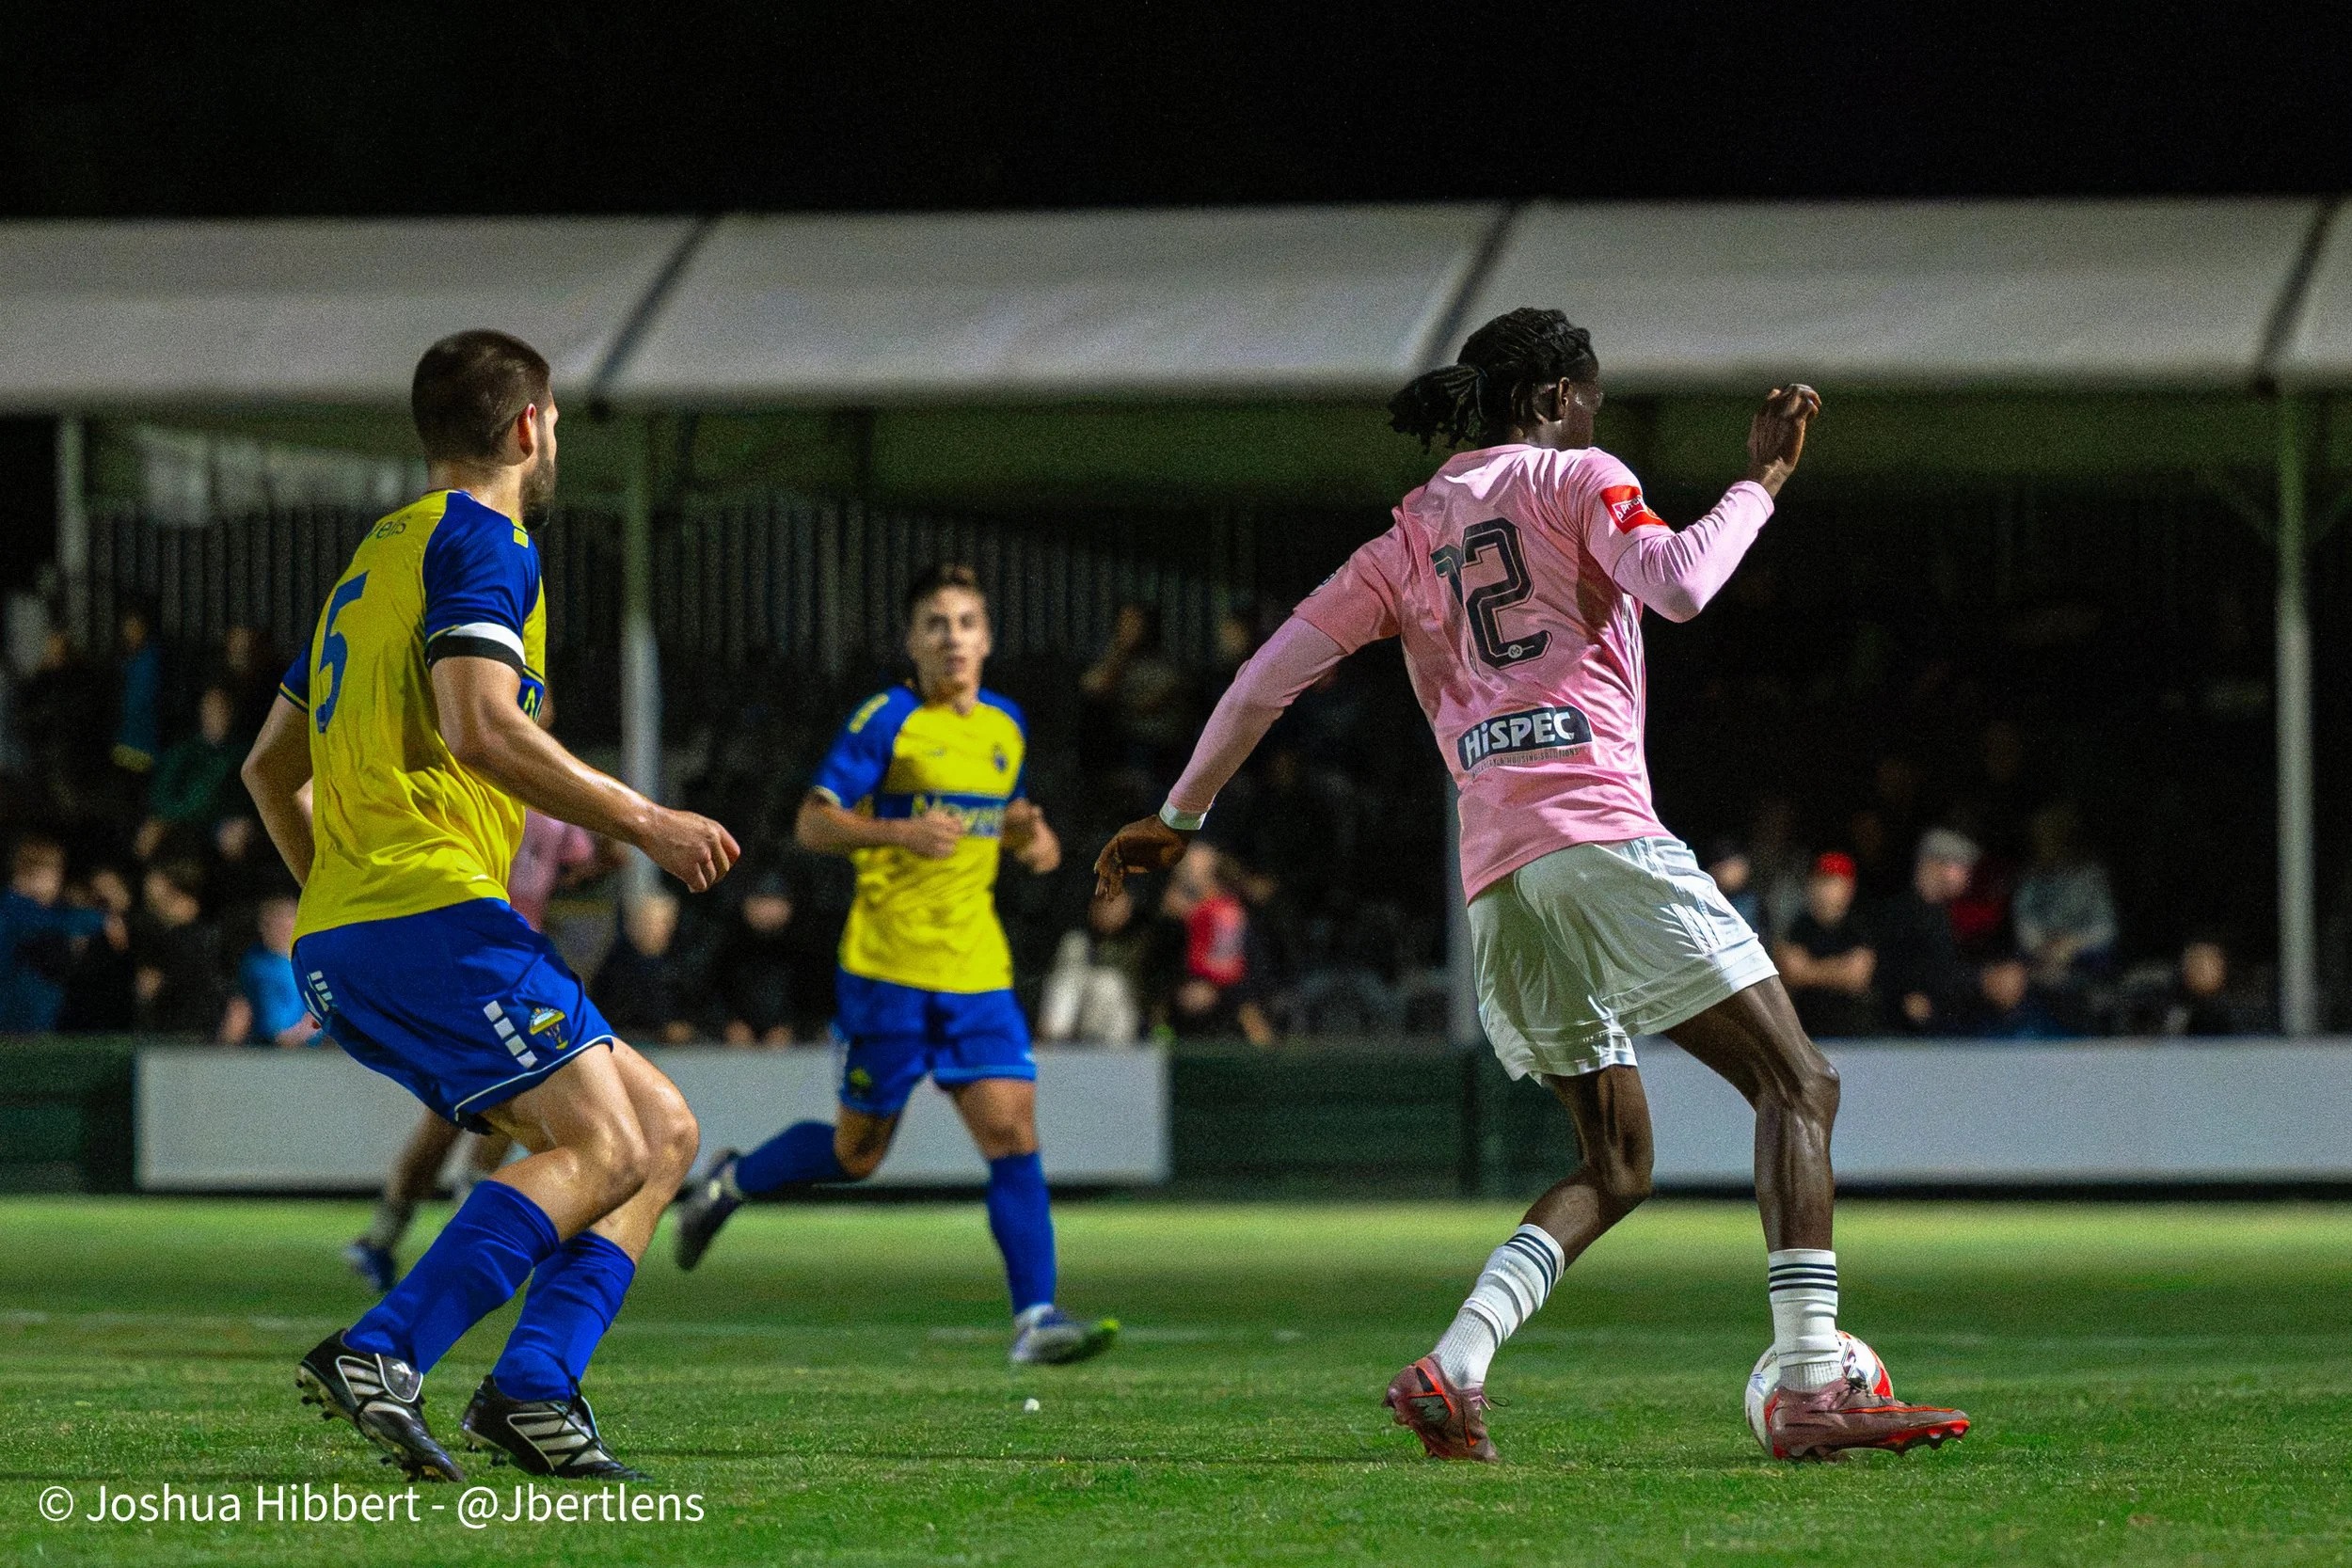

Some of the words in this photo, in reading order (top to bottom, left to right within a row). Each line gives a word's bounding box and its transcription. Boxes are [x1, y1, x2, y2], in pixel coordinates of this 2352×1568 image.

[315, 569, 370, 734] 5
[1430, 517, 1552, 670] 12
[1464, 712, 1575, 768] HiSPEC
